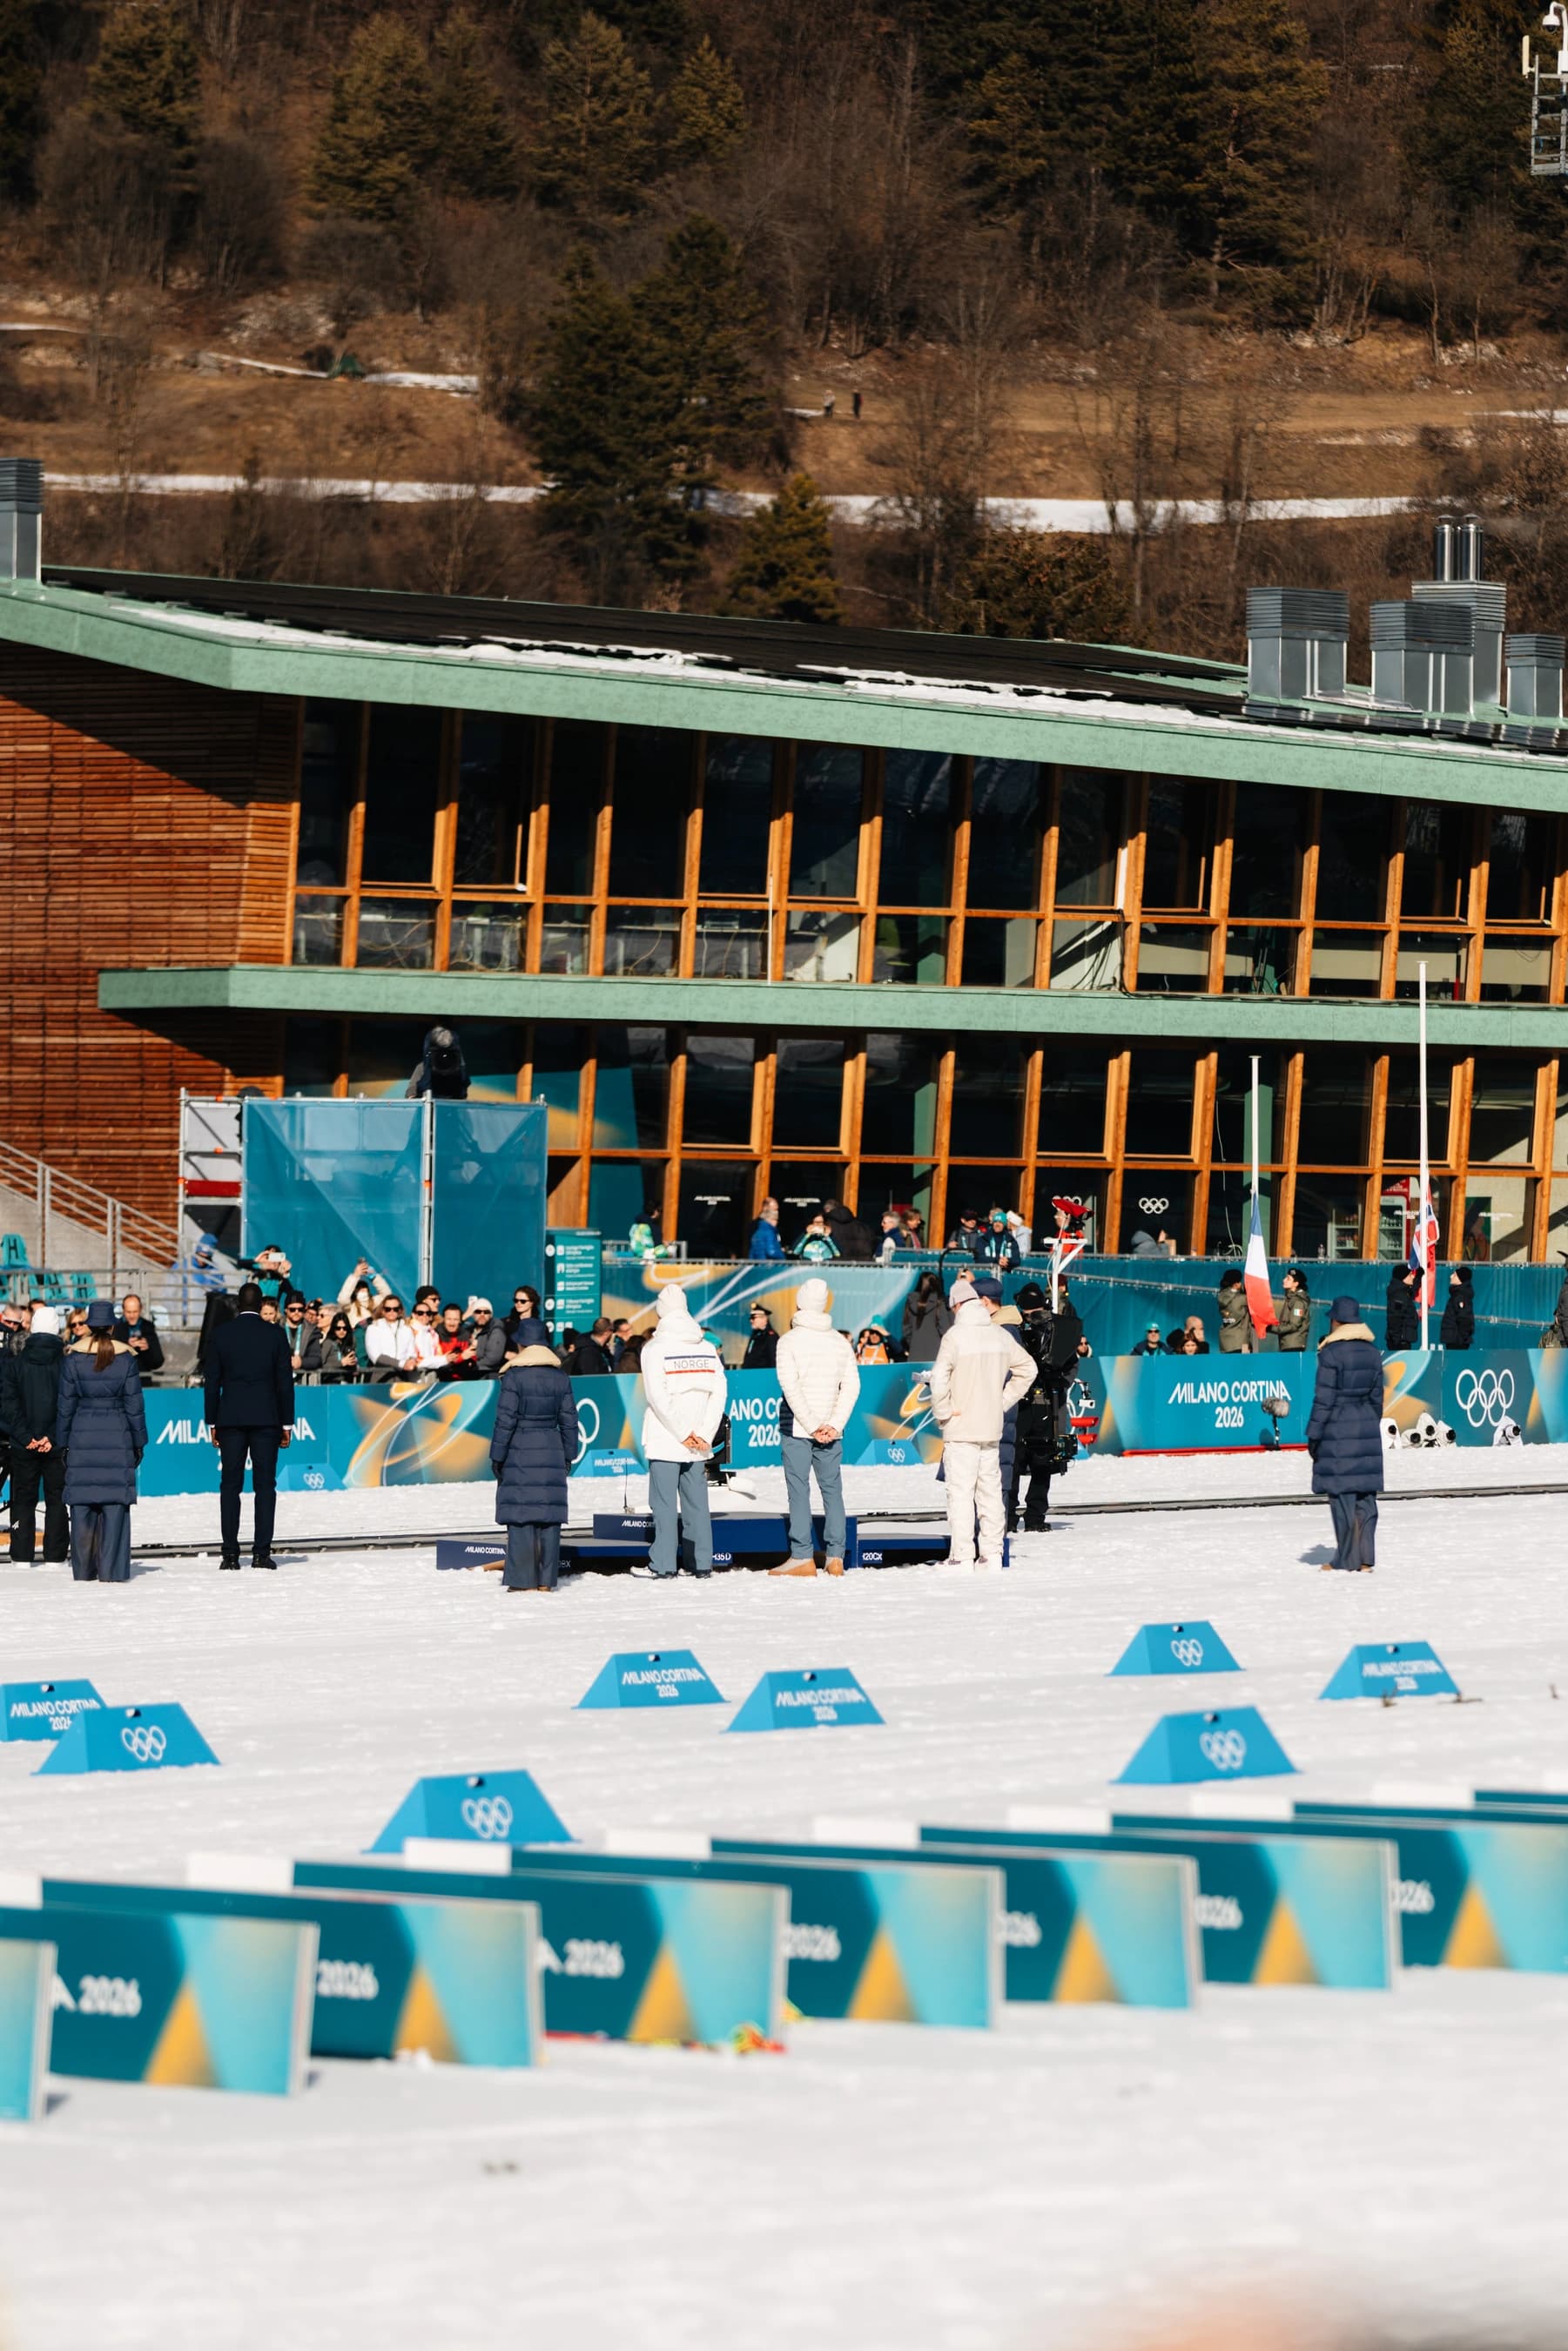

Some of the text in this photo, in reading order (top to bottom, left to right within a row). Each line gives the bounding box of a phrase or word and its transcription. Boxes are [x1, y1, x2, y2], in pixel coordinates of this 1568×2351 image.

[673, 1358, 710, 1370] NORGE
[1168, 1379, 1292, 1405] MILANO CORTINA
[729, 1398, 764, 1421] ANO
[1215, 1405, 1245, 1428] 2026
[155, 1418, 214, 1445] MILA
[748, 1423, 781, 1448] 2026
[465, 1546, 507, 1555] MILANO CORTINA
[622, 1667, 706, 1686] MILANO CORTINA
[656, 1683, 680, 1699] 2026
[10, 1697, 102, 1719] MILANO CORTINA
[562, 1937, 626, 1980] 2026
[315, 1957, 380, 2001] 2026
[77, 1973, 143, 2018] 2026
